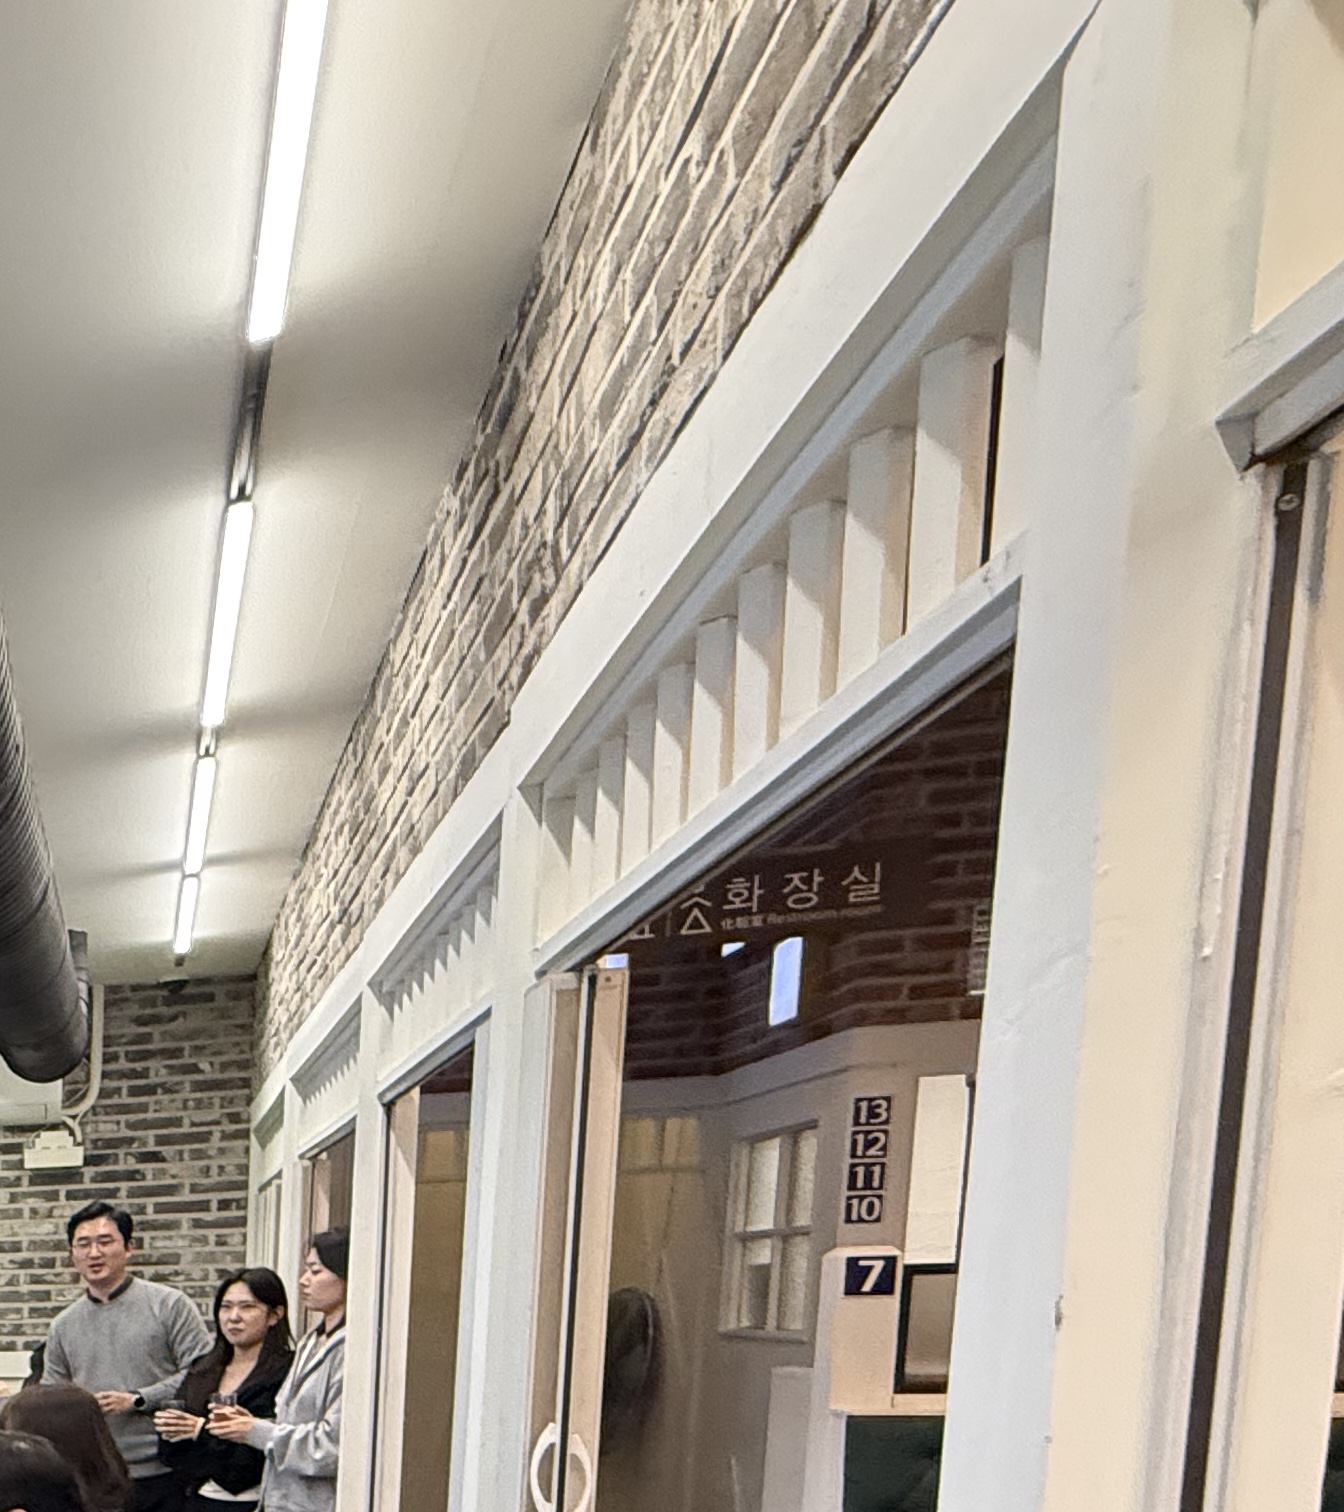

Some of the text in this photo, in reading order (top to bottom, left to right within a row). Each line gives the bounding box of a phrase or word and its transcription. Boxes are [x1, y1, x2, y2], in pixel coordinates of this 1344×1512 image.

[722, 861, 882, 912] 화장실
[855, 1100, 889, 1125] 13
[853, 1132, 887, 1157] 12
[852, 1165, 884, 1189] 11
[847, 1196, 882, 1222] 10
[858, 1259, 887, 1292] 7
